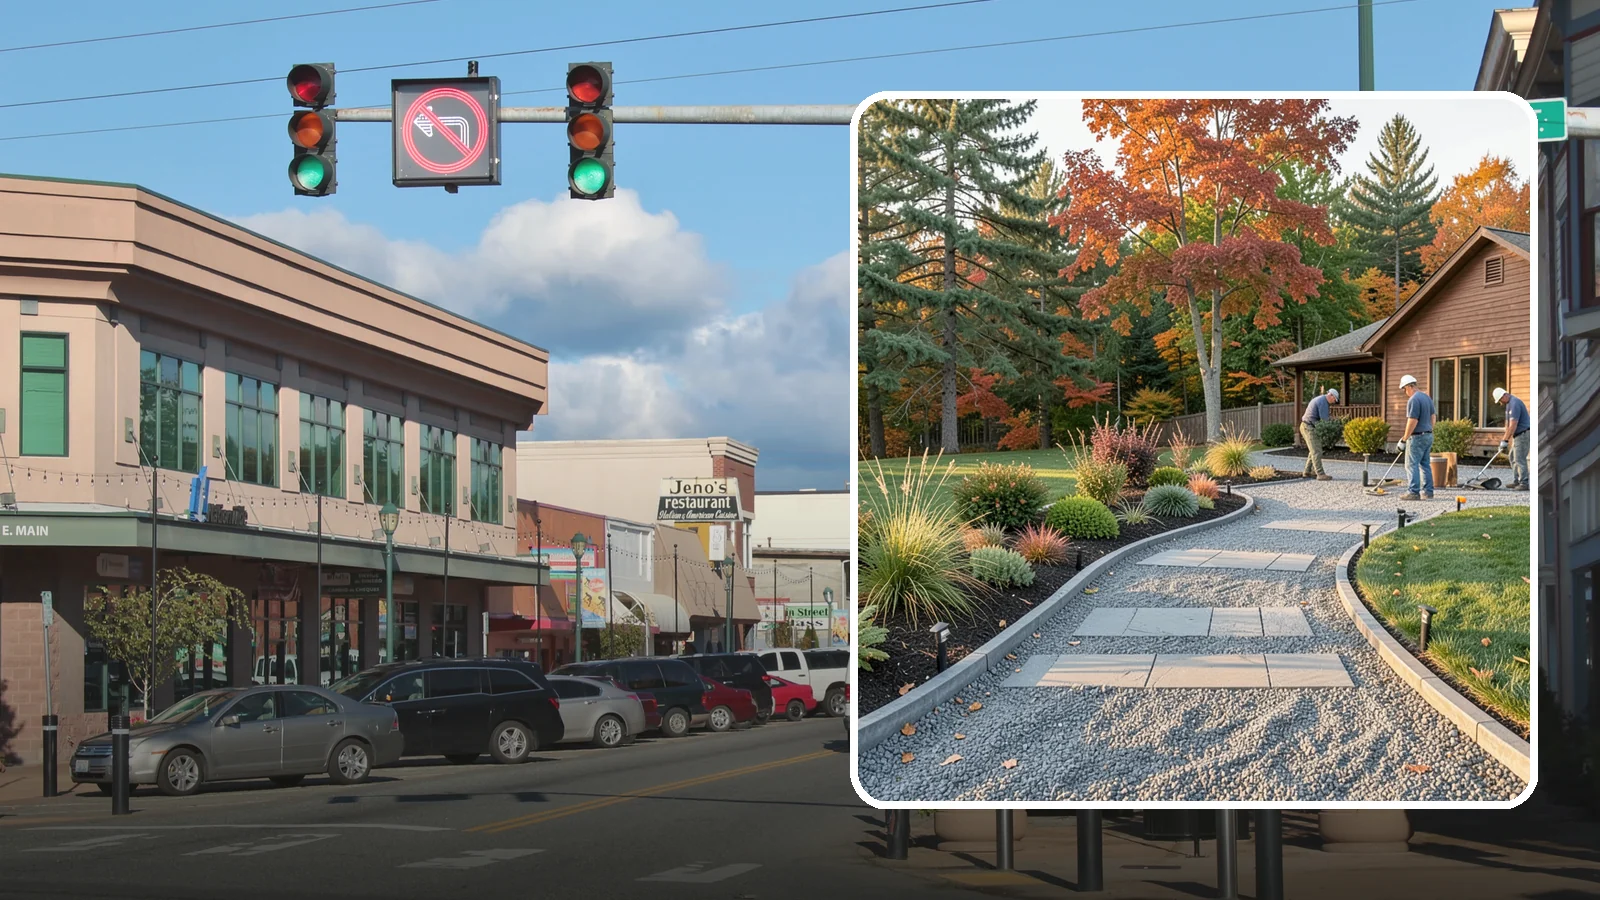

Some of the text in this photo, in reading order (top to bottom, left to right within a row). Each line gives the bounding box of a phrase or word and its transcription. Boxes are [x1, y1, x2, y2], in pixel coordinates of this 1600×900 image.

[670, 480, 727, 494] Jeno's
[665, 497, 731, 509] restaurant
[658, 510, 681, 519] Italian
[686, 509, 714, 519] American
[714, 509, 737, 519] Cuisine
[2, 525, 49, 536] E. MAIN
[797, 607, 828, 617] Street
[790, 619, 824, 627] lass
